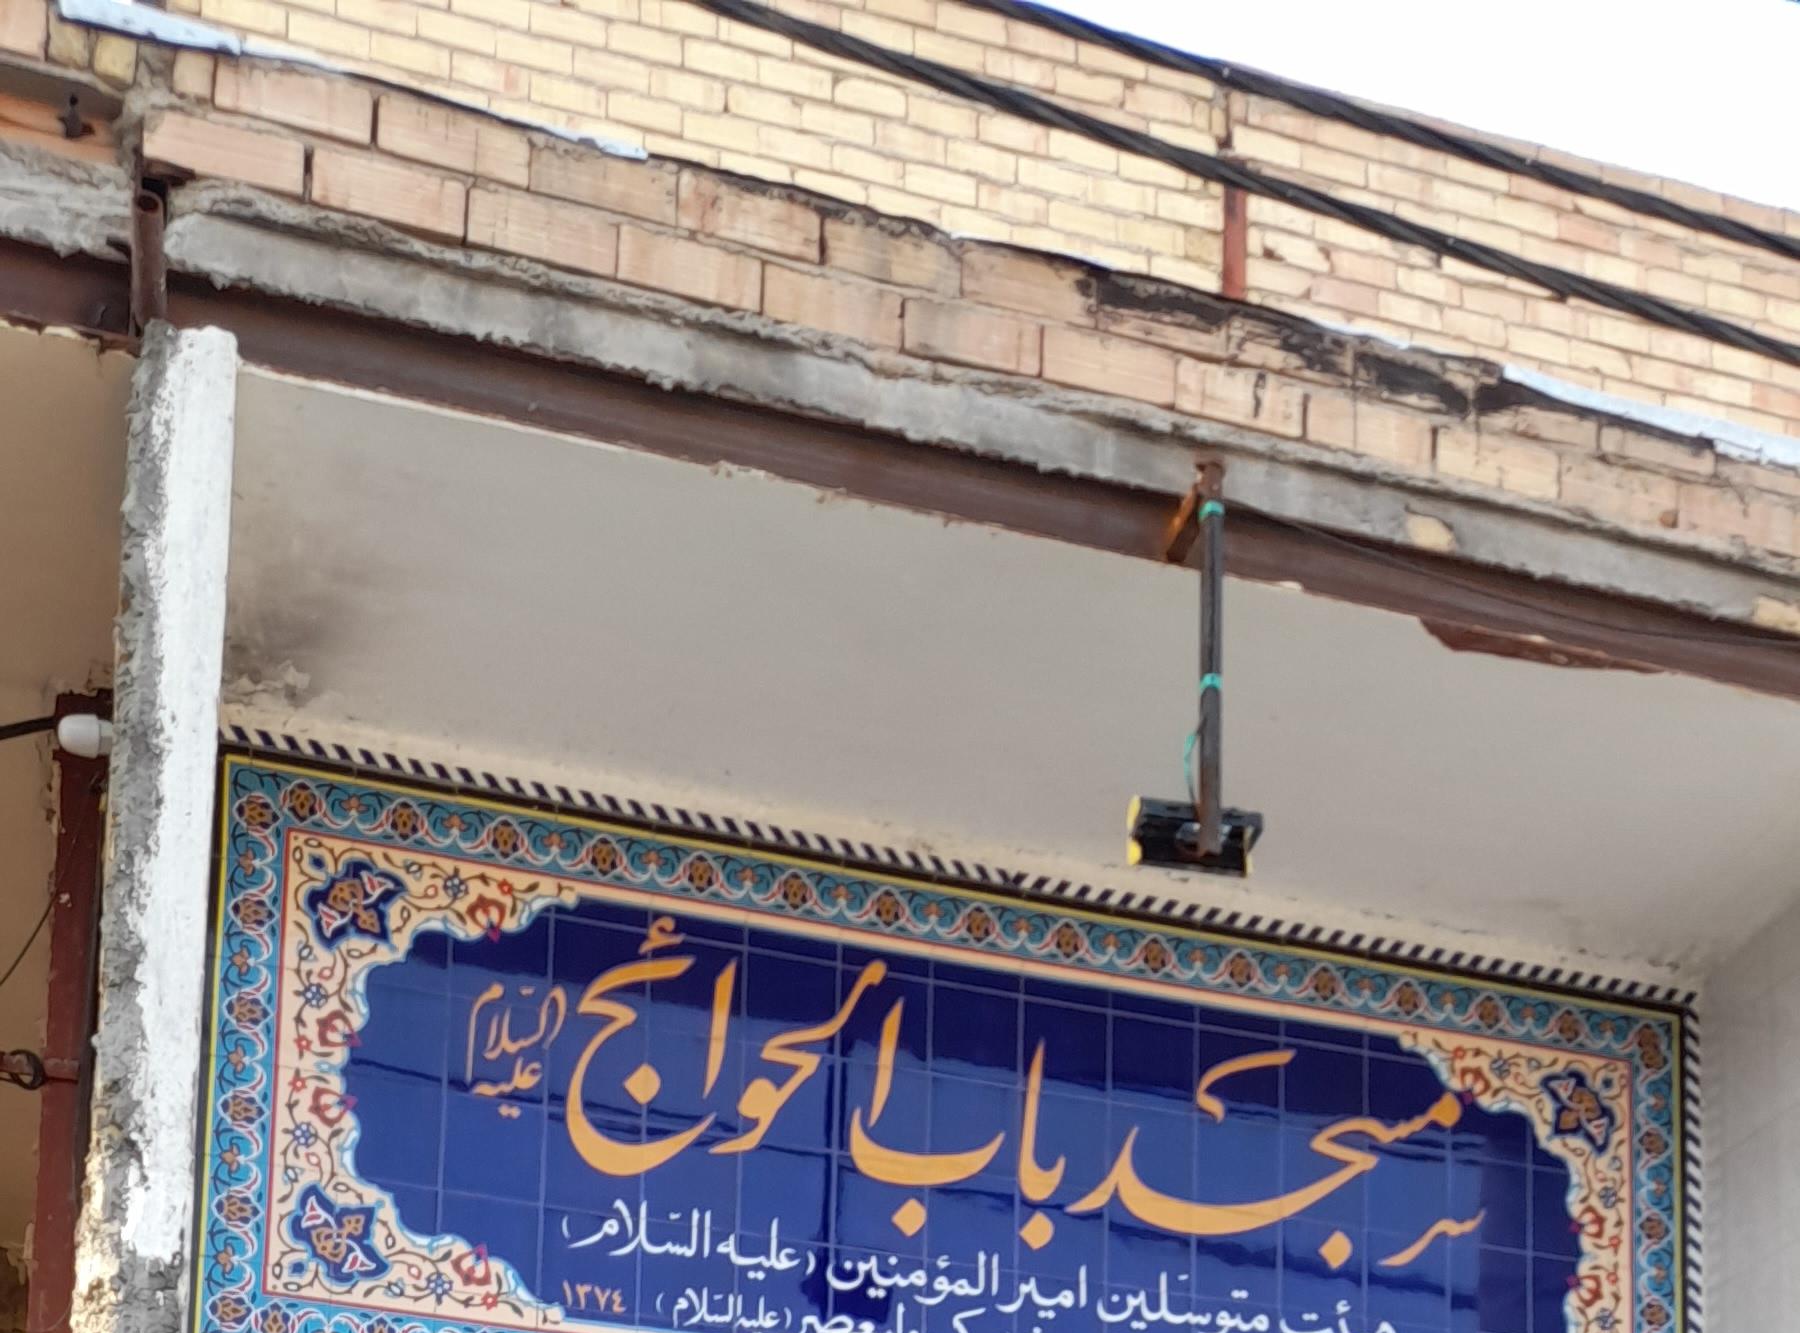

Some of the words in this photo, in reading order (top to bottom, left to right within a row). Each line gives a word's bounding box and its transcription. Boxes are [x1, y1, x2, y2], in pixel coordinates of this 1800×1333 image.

[849, 1036, 1067, 1251] باب
[1064, 1091, 1463, 1269] مسجد
[995, 1264, 1089, 1320] امیر
